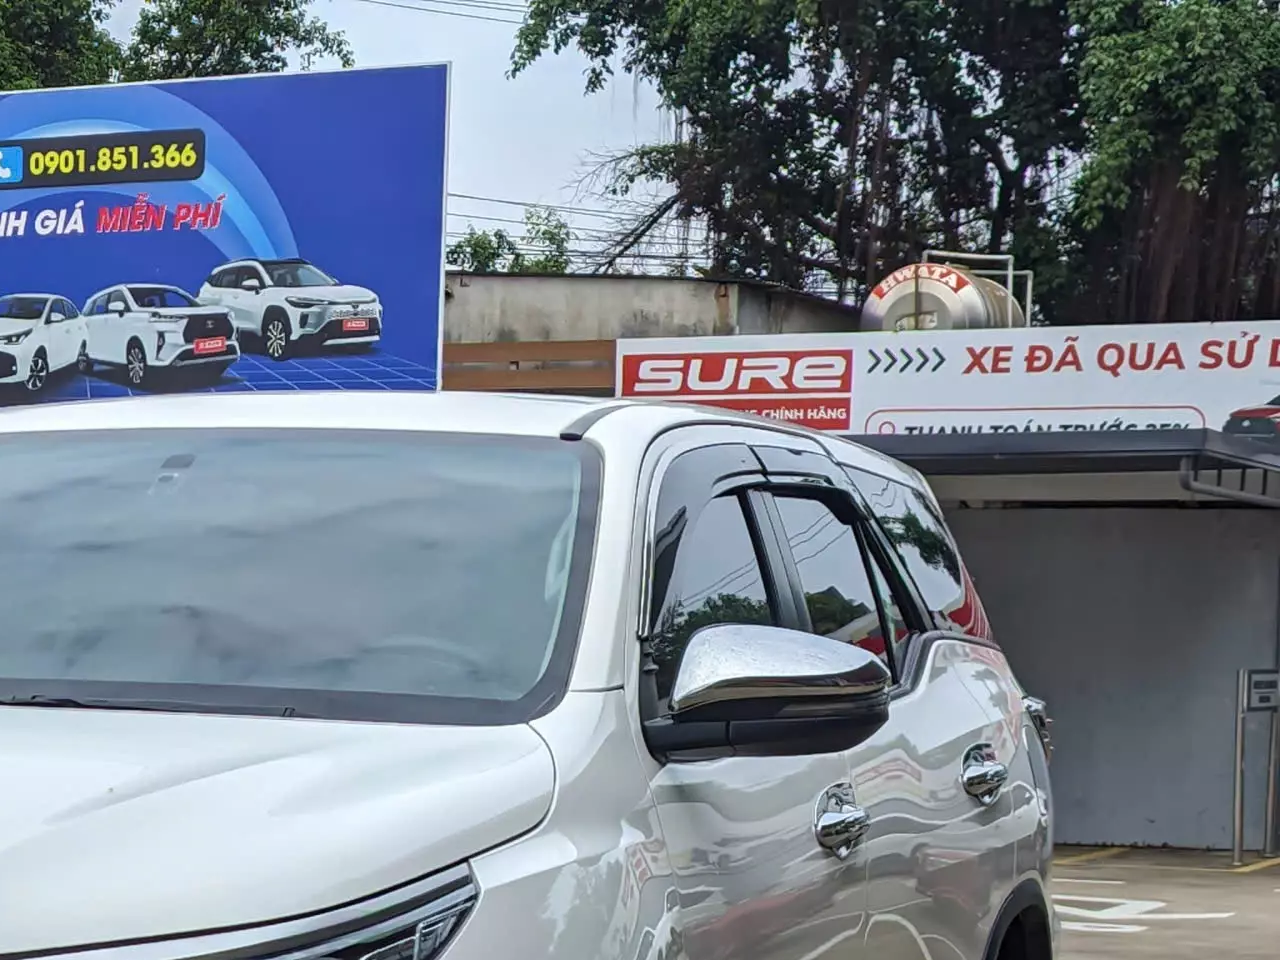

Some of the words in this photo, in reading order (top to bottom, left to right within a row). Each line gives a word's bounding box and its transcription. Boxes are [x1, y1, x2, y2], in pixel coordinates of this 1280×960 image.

[29, 142, 197, 176] 0901.851.366
[34, 199, 85, 236] GIÁ
[96, 192, 168, 233] MIỄN
[173, 192, 227, 231] PHÍ
[962, 345, 1014, 375] XE
[1024, 335, 1083, 374] ĐÃ
[1096, 341, 1187, 377] QUA
[1198, 331, 1261, 370] SỬ
[761, 406, 804, 420] CHÍNH
[807, 405, 847, 420] HÃNG
